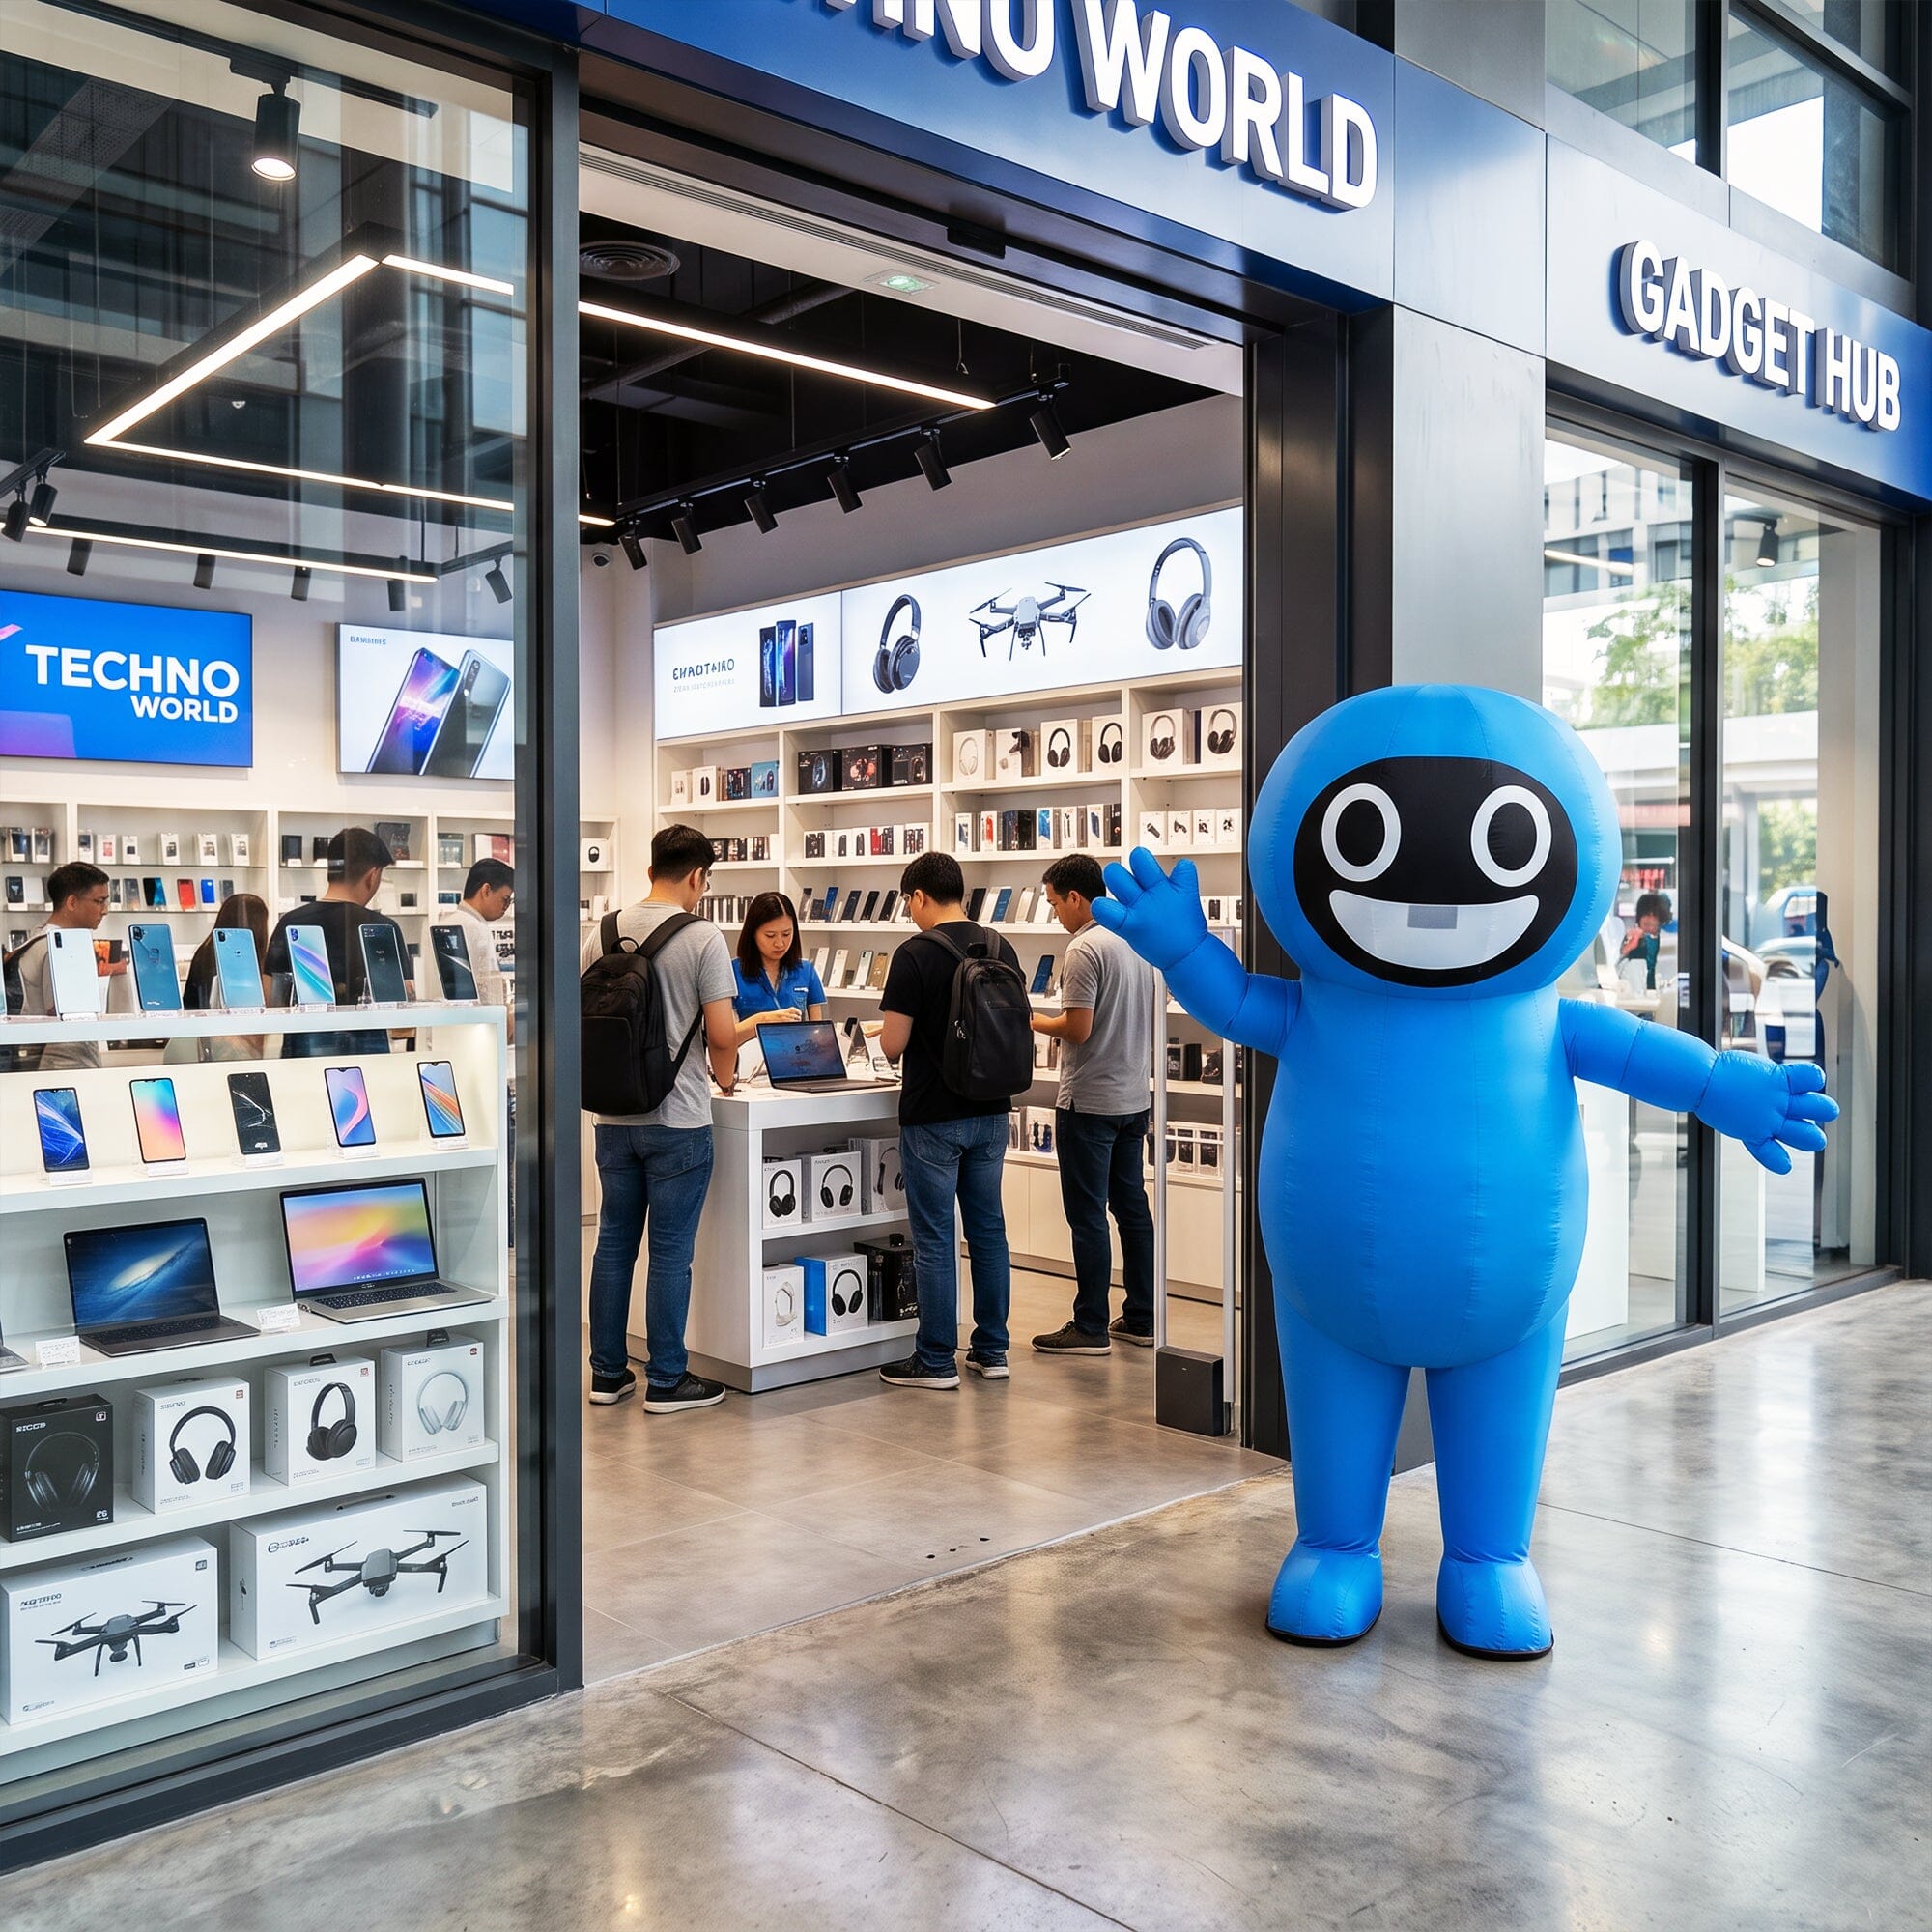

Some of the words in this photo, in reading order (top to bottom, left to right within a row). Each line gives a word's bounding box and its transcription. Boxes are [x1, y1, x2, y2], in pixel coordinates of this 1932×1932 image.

[1072, 0, 1378, 209] WORLD
[1621, 240, 1815, 395] GADGET
[1816, 327, 1901, 432] HUB
[25, 644, 240, 698] TECHNO
[129, 695, 239, 724] WORLD
